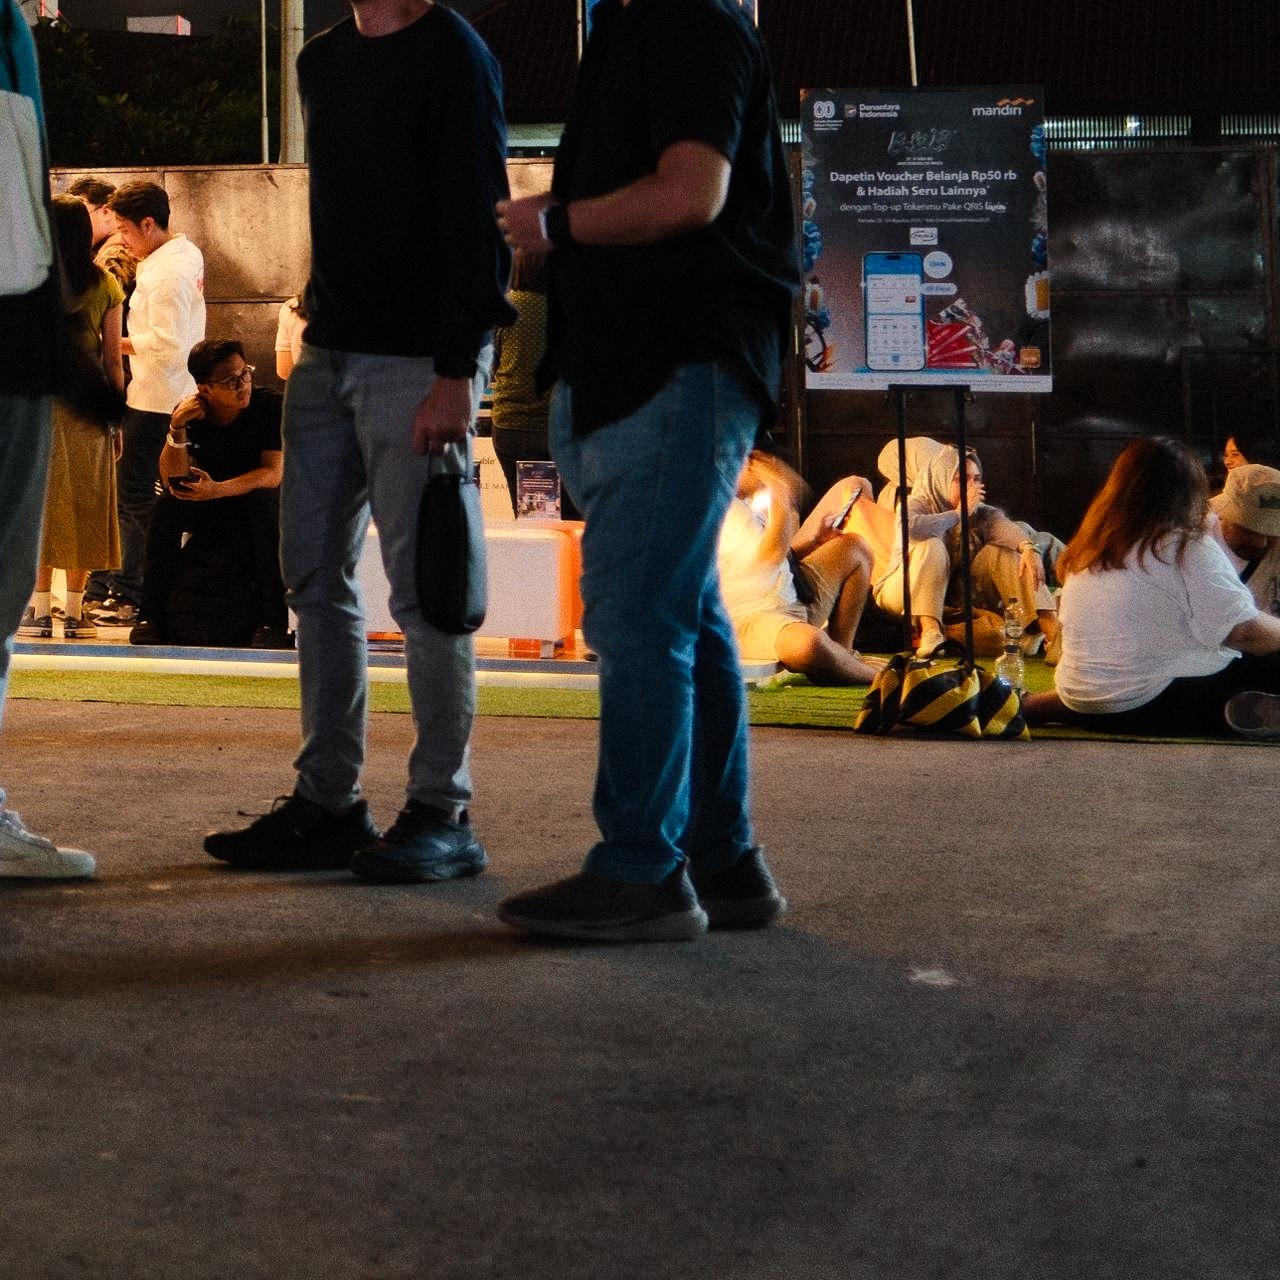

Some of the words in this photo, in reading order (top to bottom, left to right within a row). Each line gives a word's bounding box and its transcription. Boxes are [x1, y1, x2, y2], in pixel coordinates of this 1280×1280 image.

[830, 172, 875, 184] Dapetin
[876, 171, 924, 181] Voucher
[926, 171, 969, 183] Belanja
[971, 170, 1002, 182] Rp50
[1003, 170, 1017, 181] rb
[856, 186, 866, 196] &
[867, 185, 909, 196] Hadiah
[911, 186, 938, 196] Seru
[840, 202, 871, 213] dengan
